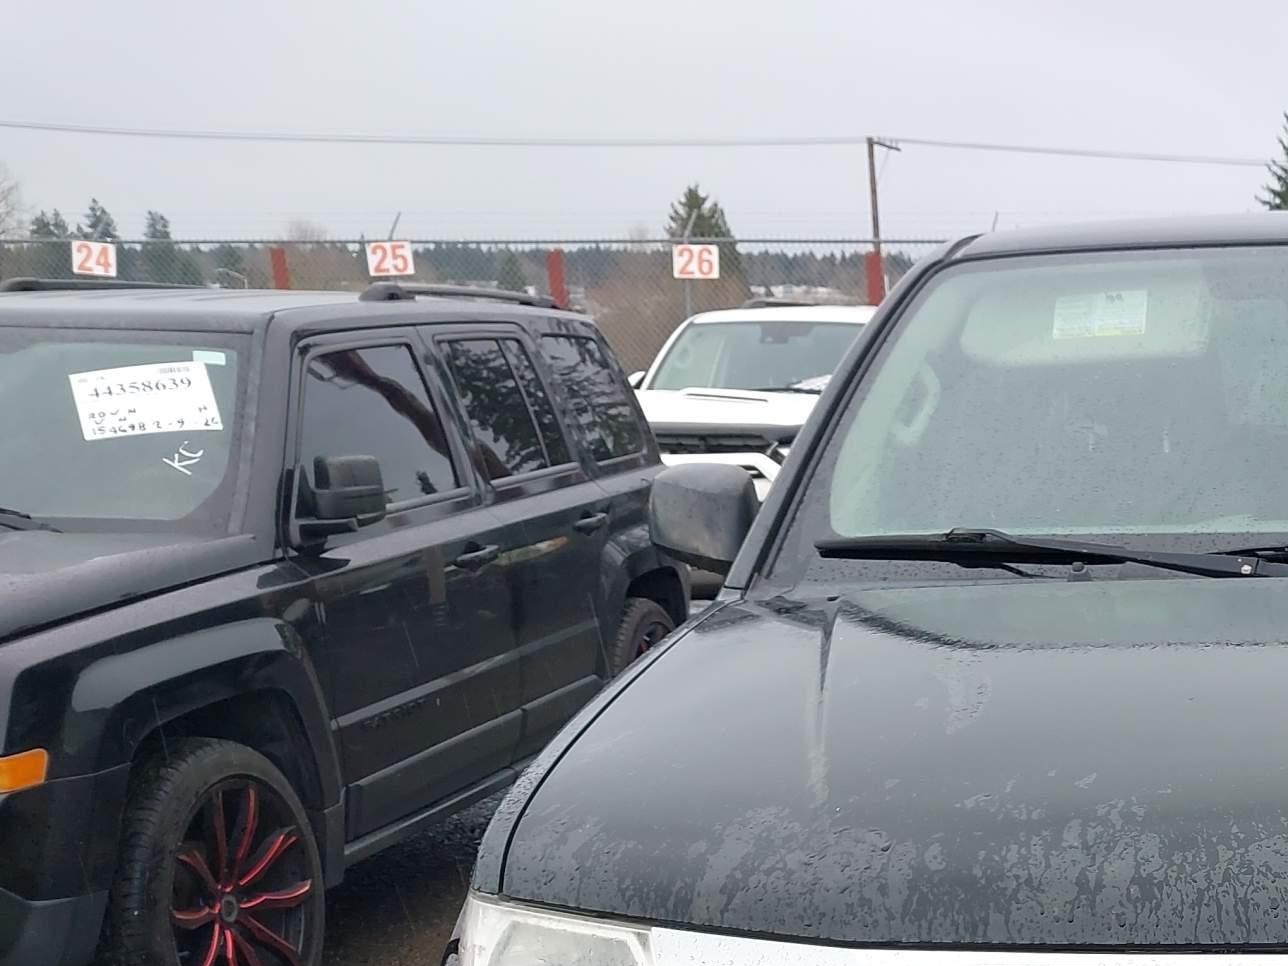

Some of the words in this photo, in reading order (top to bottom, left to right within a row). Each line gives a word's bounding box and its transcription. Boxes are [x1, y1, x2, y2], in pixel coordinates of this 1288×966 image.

[76, 243, 113, 274] 24
[371, 244, 409, 273] 25
[678, 247, 714, 276] 26
[88, 377, 192, 398] 44358639
